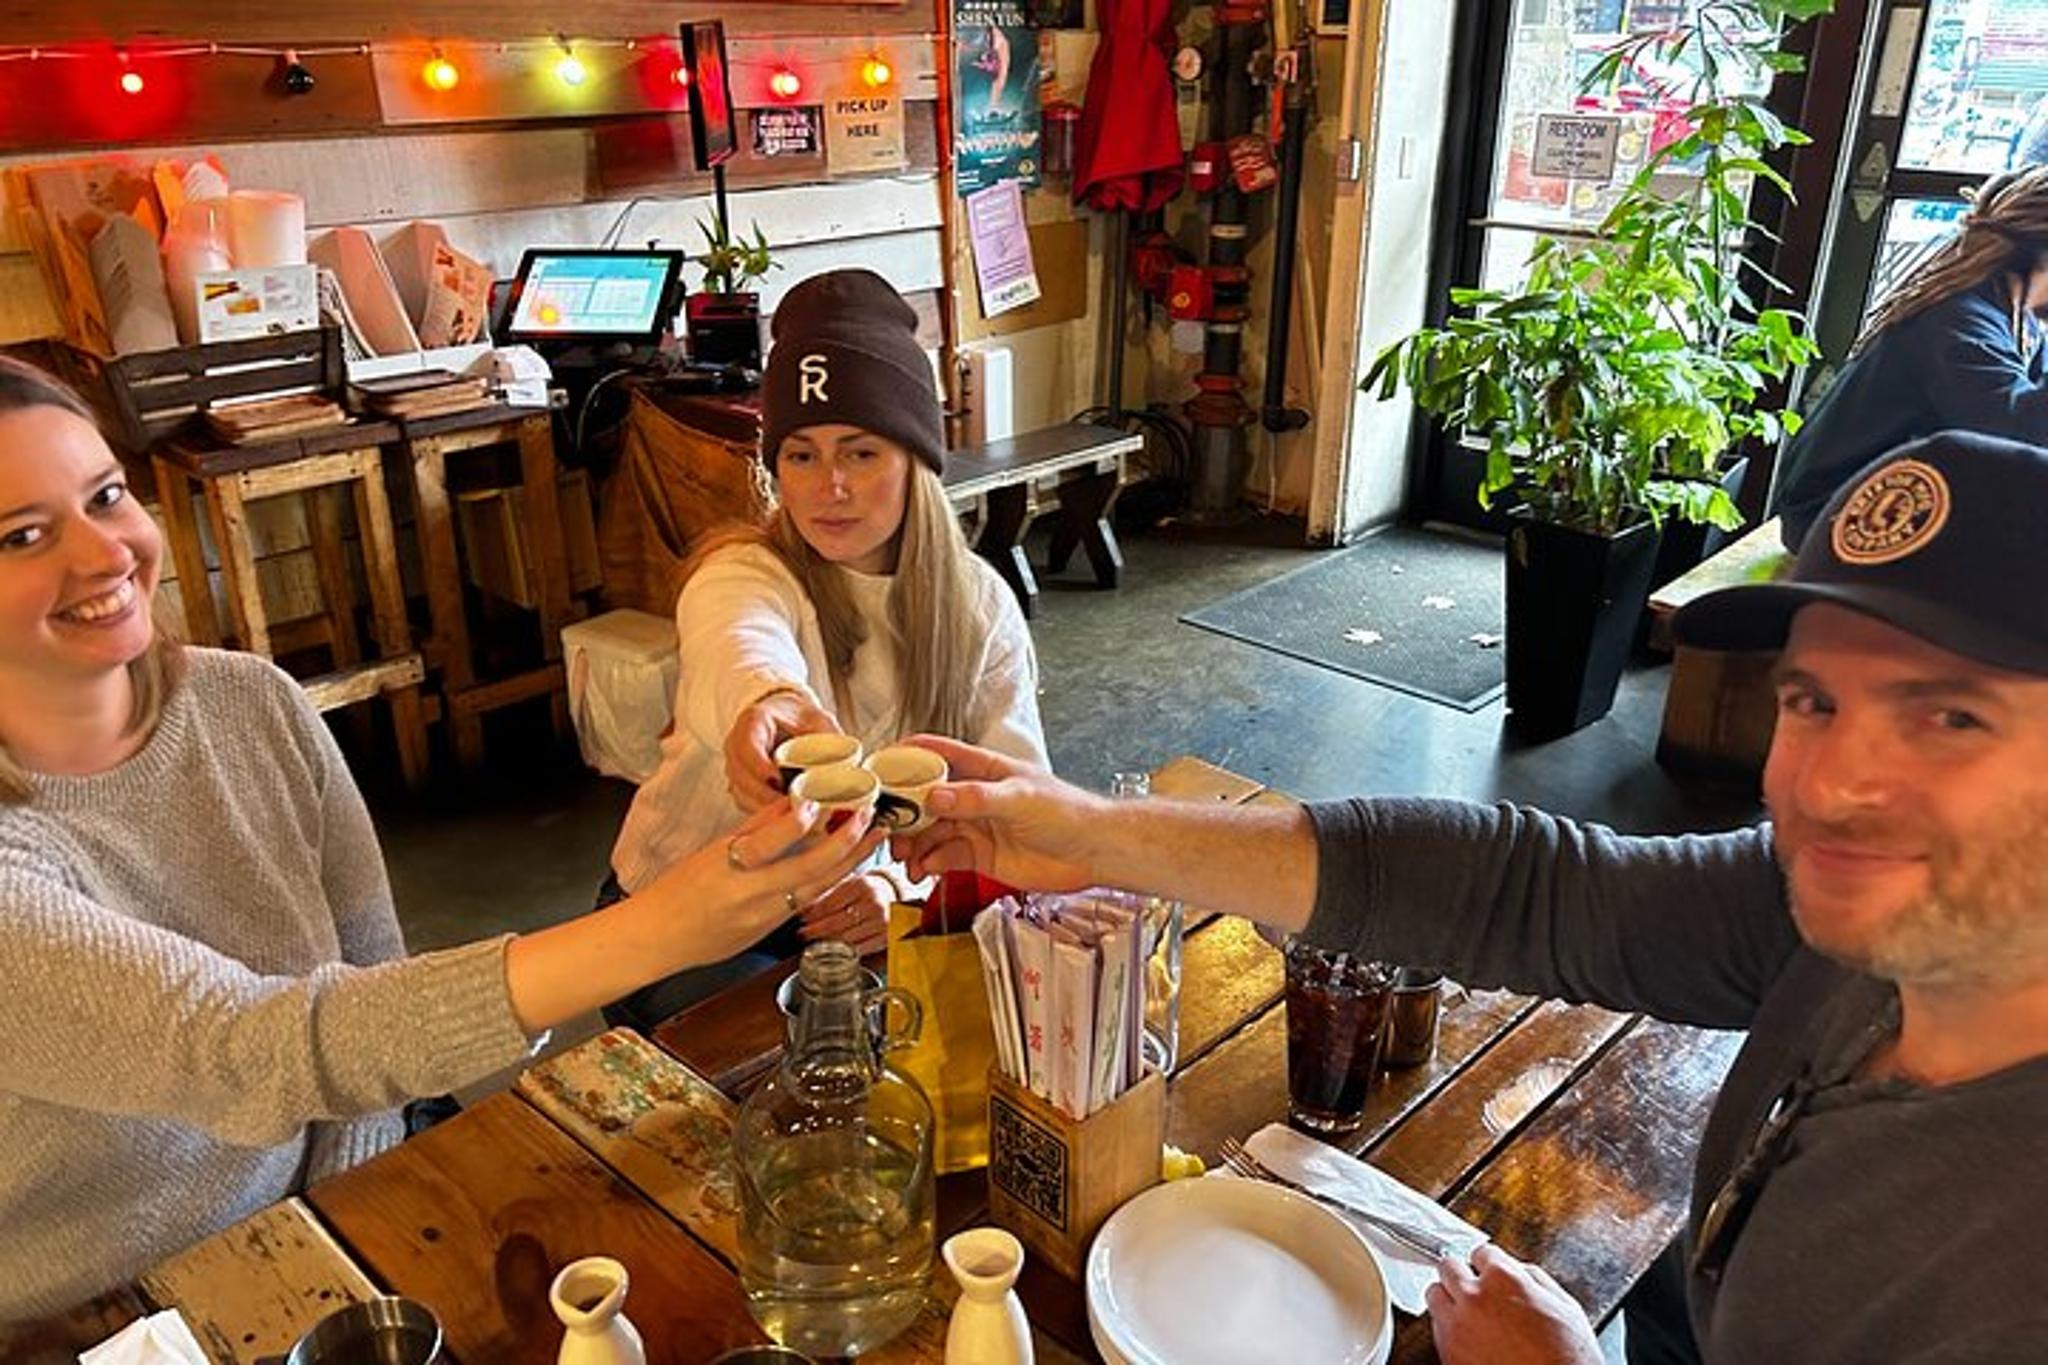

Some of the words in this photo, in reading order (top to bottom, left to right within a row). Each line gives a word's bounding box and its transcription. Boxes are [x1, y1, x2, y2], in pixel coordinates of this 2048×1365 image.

[956, 12, 994, 27] SHEN
[995, 12, 1025, 27] YUN
[837, 101, 868, 114] PICK
[870, 99, 888, 111] UP
[847, 124, 880, 137] HERE
[1547, 121, 1607, 138] RESTROOM
